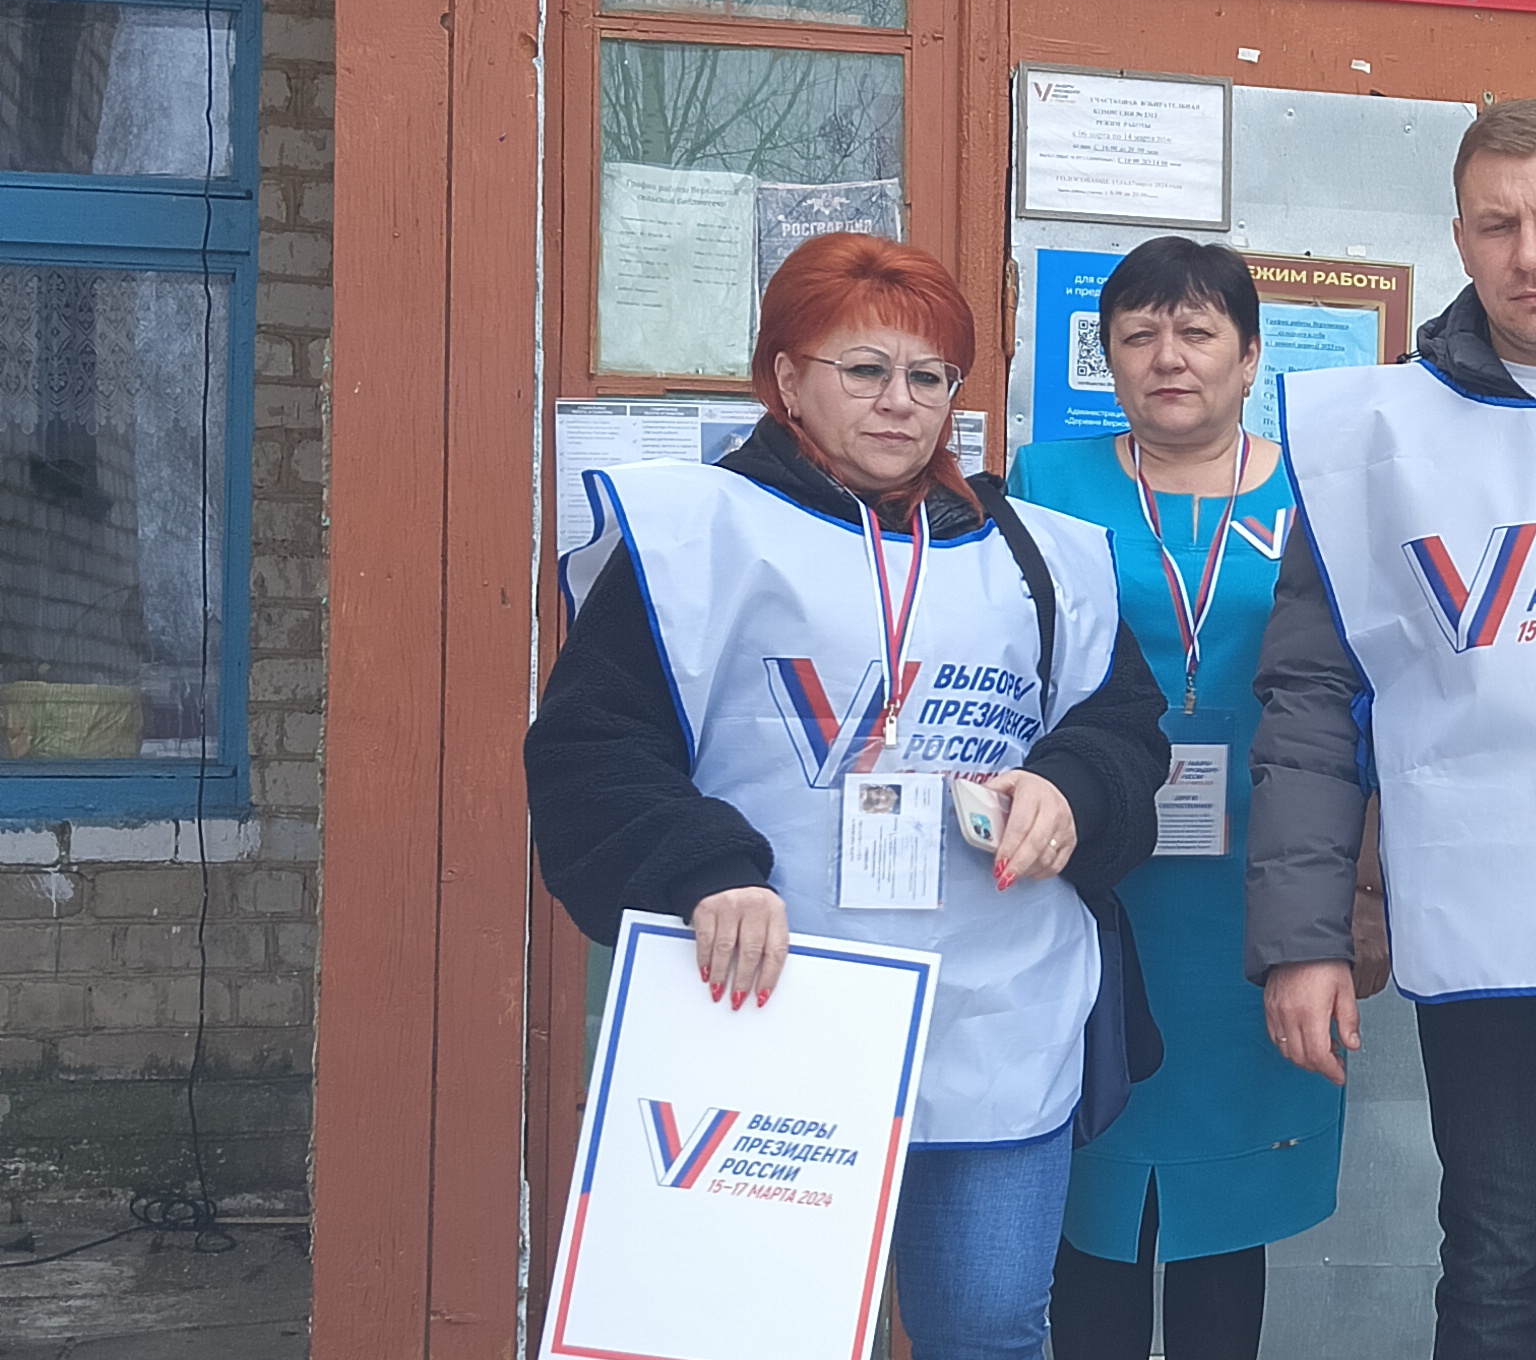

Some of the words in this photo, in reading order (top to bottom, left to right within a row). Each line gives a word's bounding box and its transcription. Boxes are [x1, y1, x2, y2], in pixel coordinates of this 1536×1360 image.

[1247, 265, 1307, 284] ЕЖИМ
[1313, 271, 1396, 291] РАБОТЫ
[1075, 287, 1101, 298] пред
[933, 663, 1036, 702] ВЫБОРЫ
[917, 698, 1042, 743] ПРЕЗИДЕНТА
[902, 733, 1009, 766] РОССИИ
[746, 1113, 838, 1140] ВЫБОРЫ
[732, 1135, 859, 1167] ПРЕЗИДЕНТА
[718, 1157, 802, 1183] РОССИИ
[747, 1182, 797, 1204] МАРТА
[797, 1189, 833, 1208] 2024
